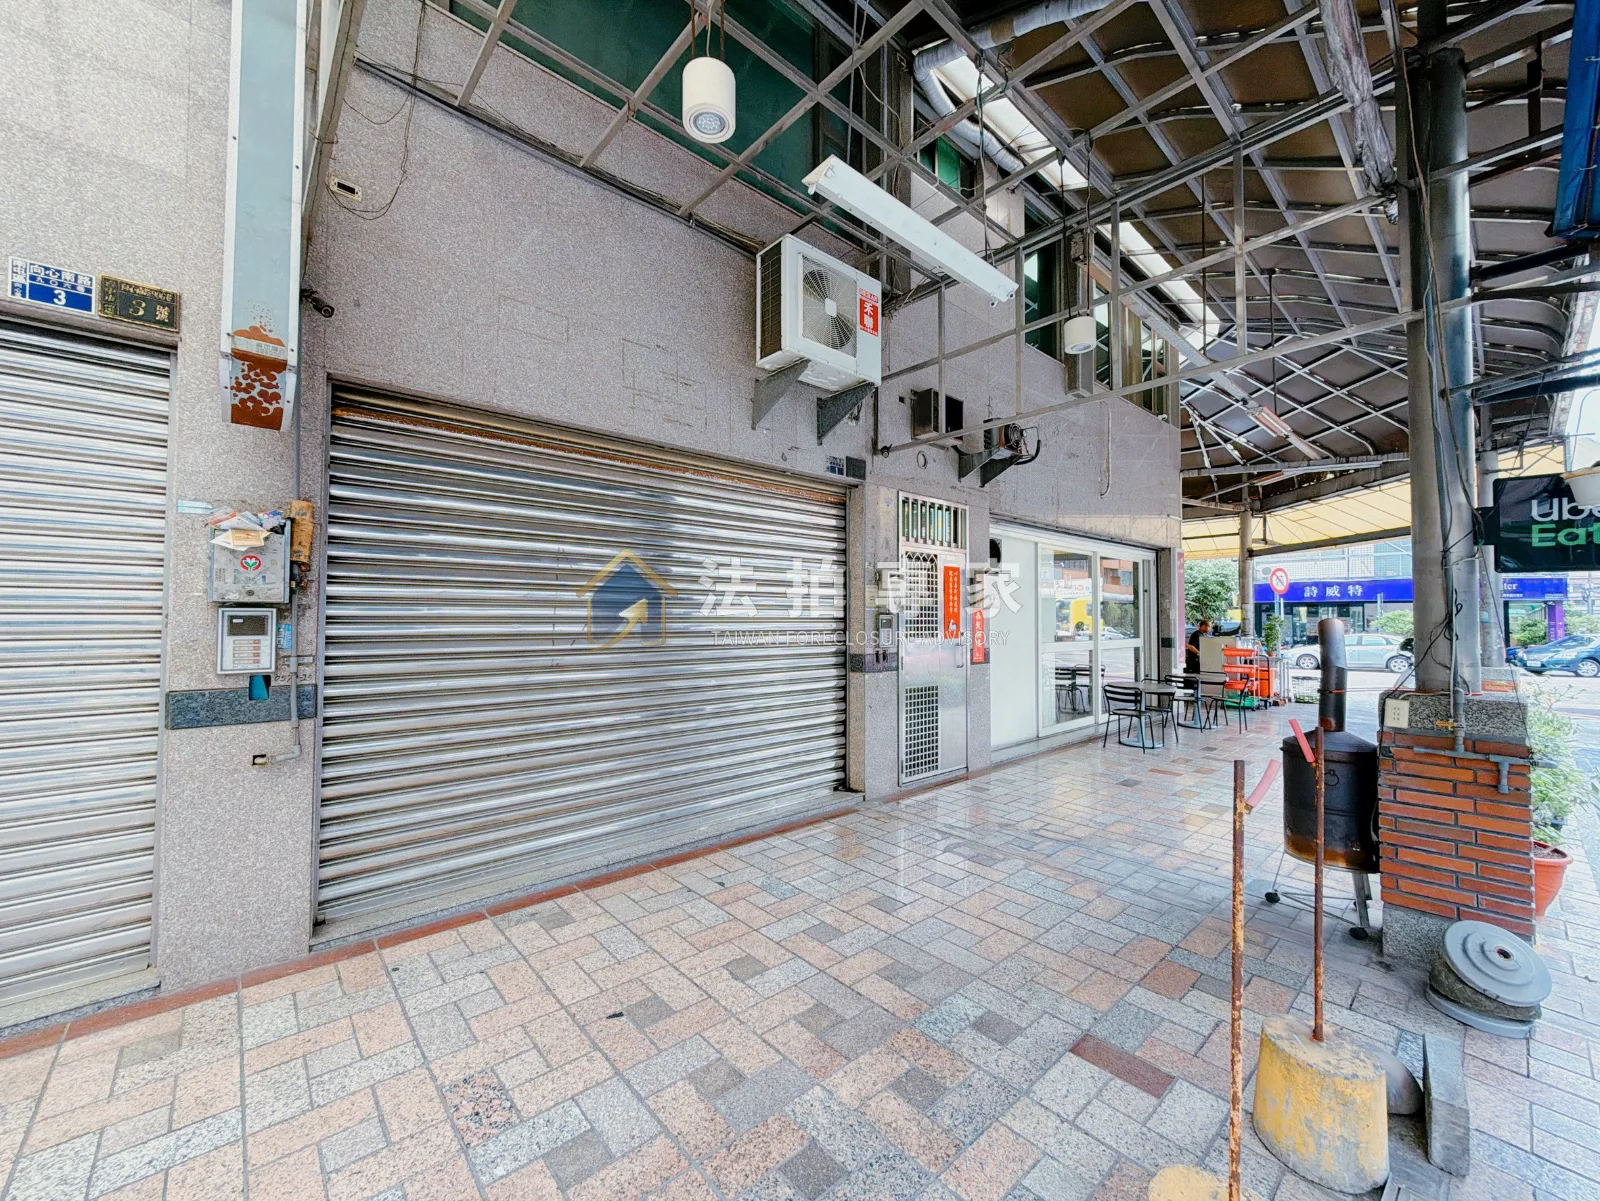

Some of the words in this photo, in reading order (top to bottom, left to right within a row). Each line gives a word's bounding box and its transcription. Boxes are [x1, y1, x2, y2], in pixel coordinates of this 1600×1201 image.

[30, 264, 91, 286] 向心南路
[53, 289, 67, 306] 3
[1303, 584, 1363, 598] 詩威特
